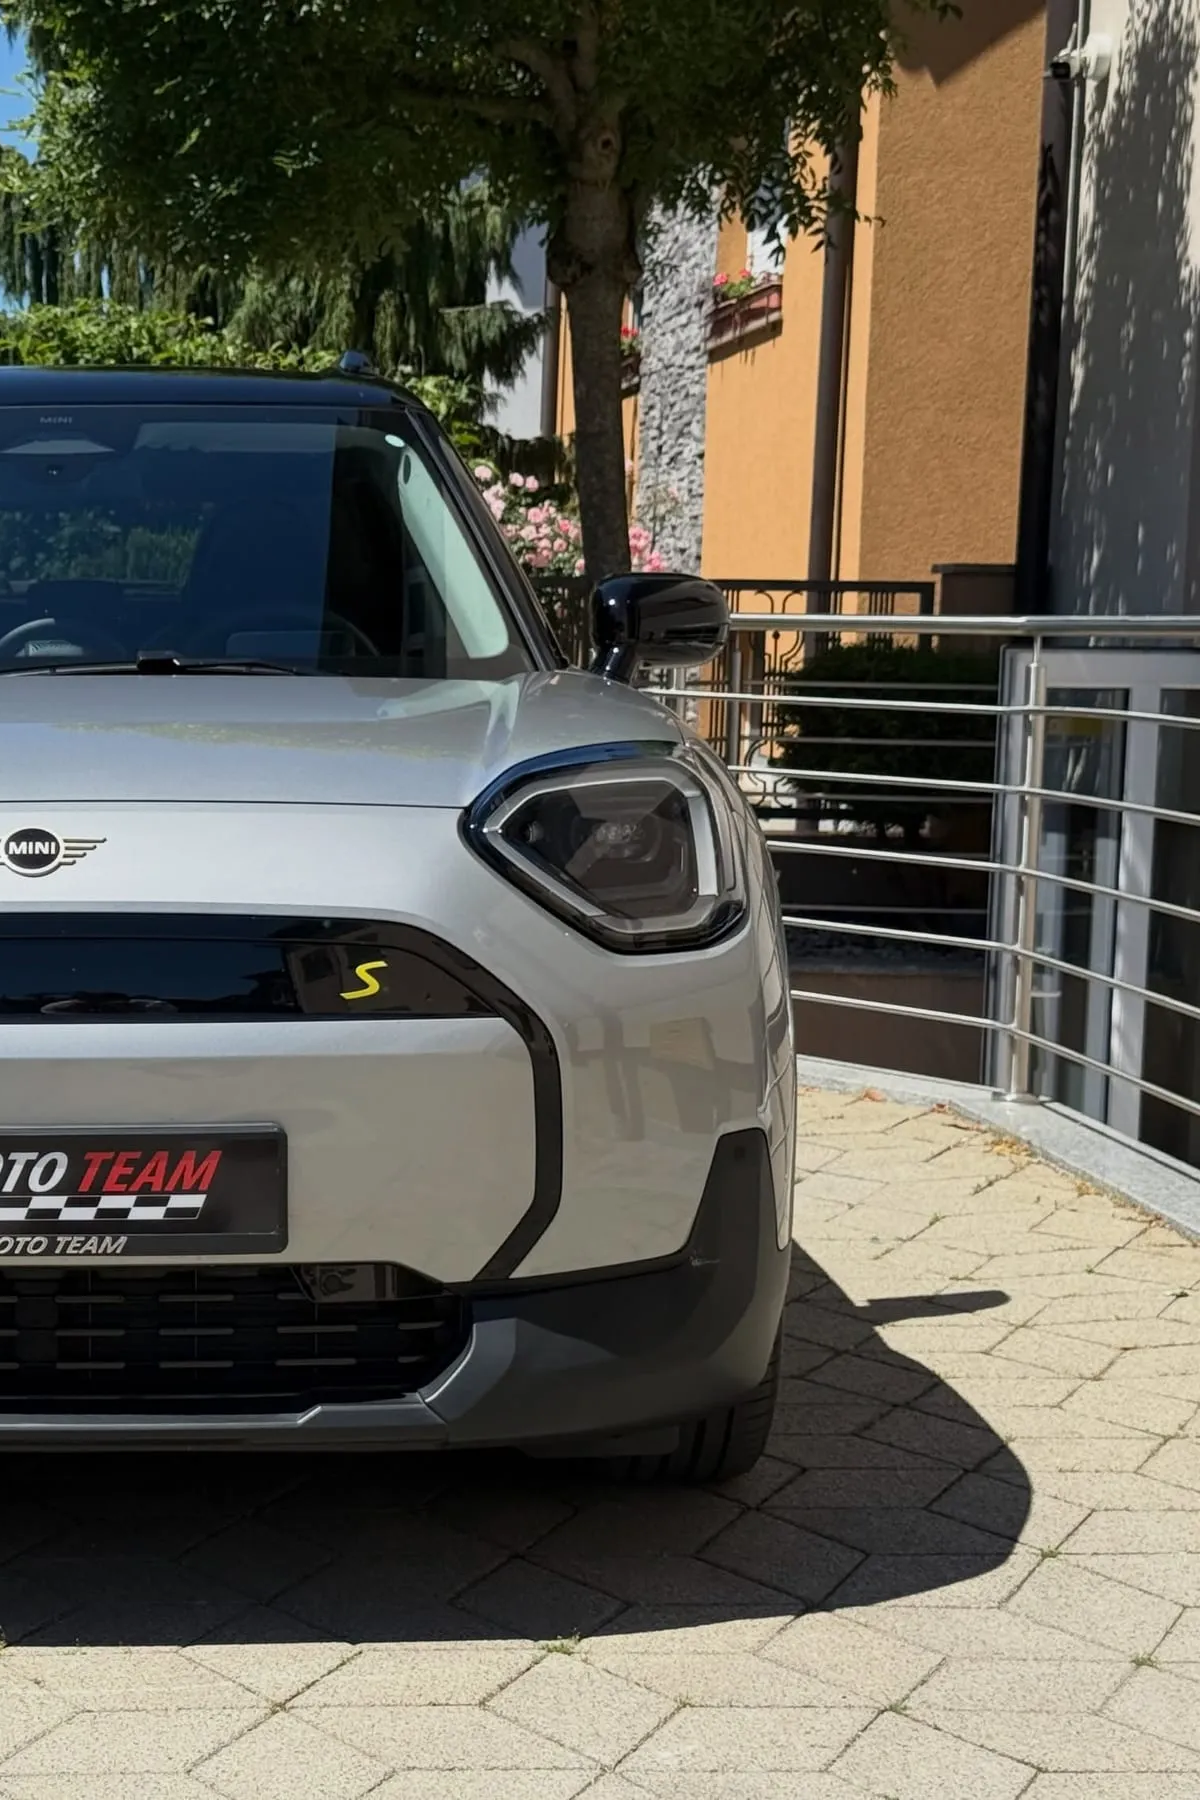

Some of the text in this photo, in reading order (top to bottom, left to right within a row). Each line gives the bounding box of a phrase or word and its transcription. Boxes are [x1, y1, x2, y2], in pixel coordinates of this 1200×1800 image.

[40, 416, 72, 424] MINI
[8, 841, 56, 855] MINI
[340, 961, 388, 1000] S
[78, 1150, 222, 1192] TEAM
[54, 1236, 127, 1254] TEAM
